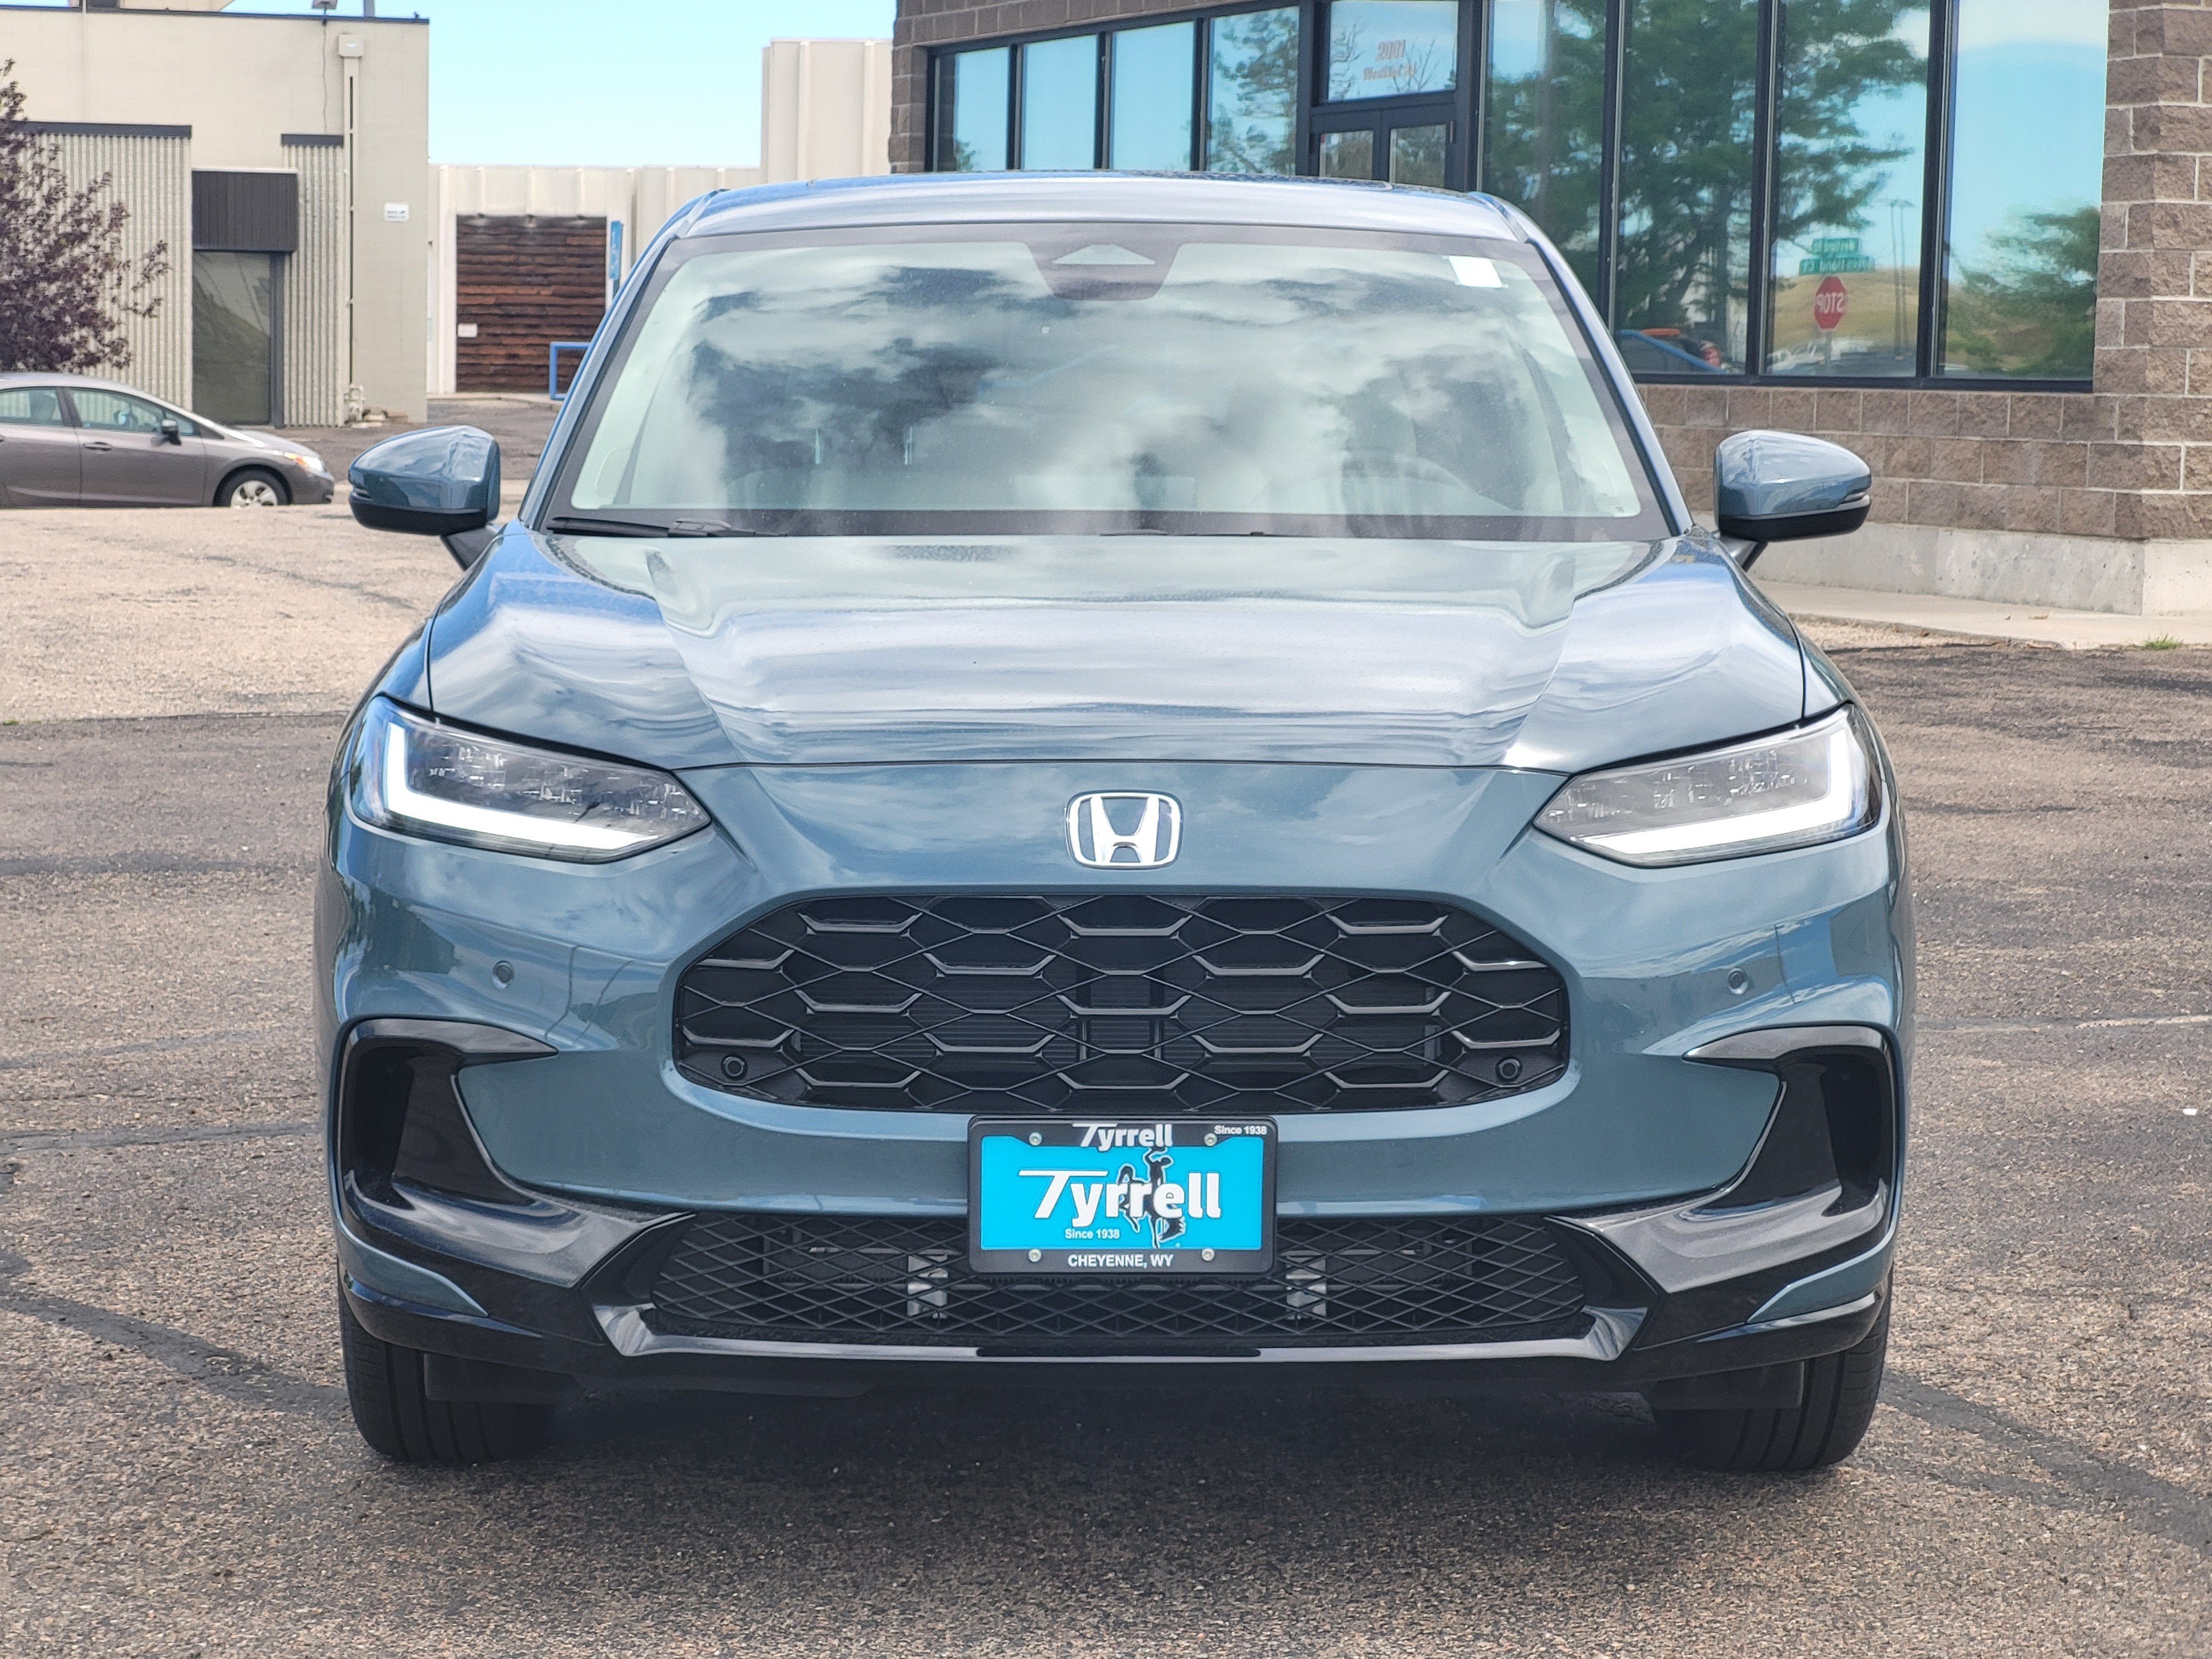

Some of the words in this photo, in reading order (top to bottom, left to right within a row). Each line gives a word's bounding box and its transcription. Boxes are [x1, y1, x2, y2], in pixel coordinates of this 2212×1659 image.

[1072, 1123, 1173, 1152] Tyrrell
[1214, 1125, 1242, 1135] Since
[1244, 1125, 1267, 1135] 1938
[1018, 1169, 1220, 1227] Tyrrell
[1065, 1228, 1094, 1239] Since
[1096, 1228, 1120, 1239] 1938
[1068, 1254, 1147, 1269] CHEYENNE,
[1150, 1254, 1174, 1267] WY
